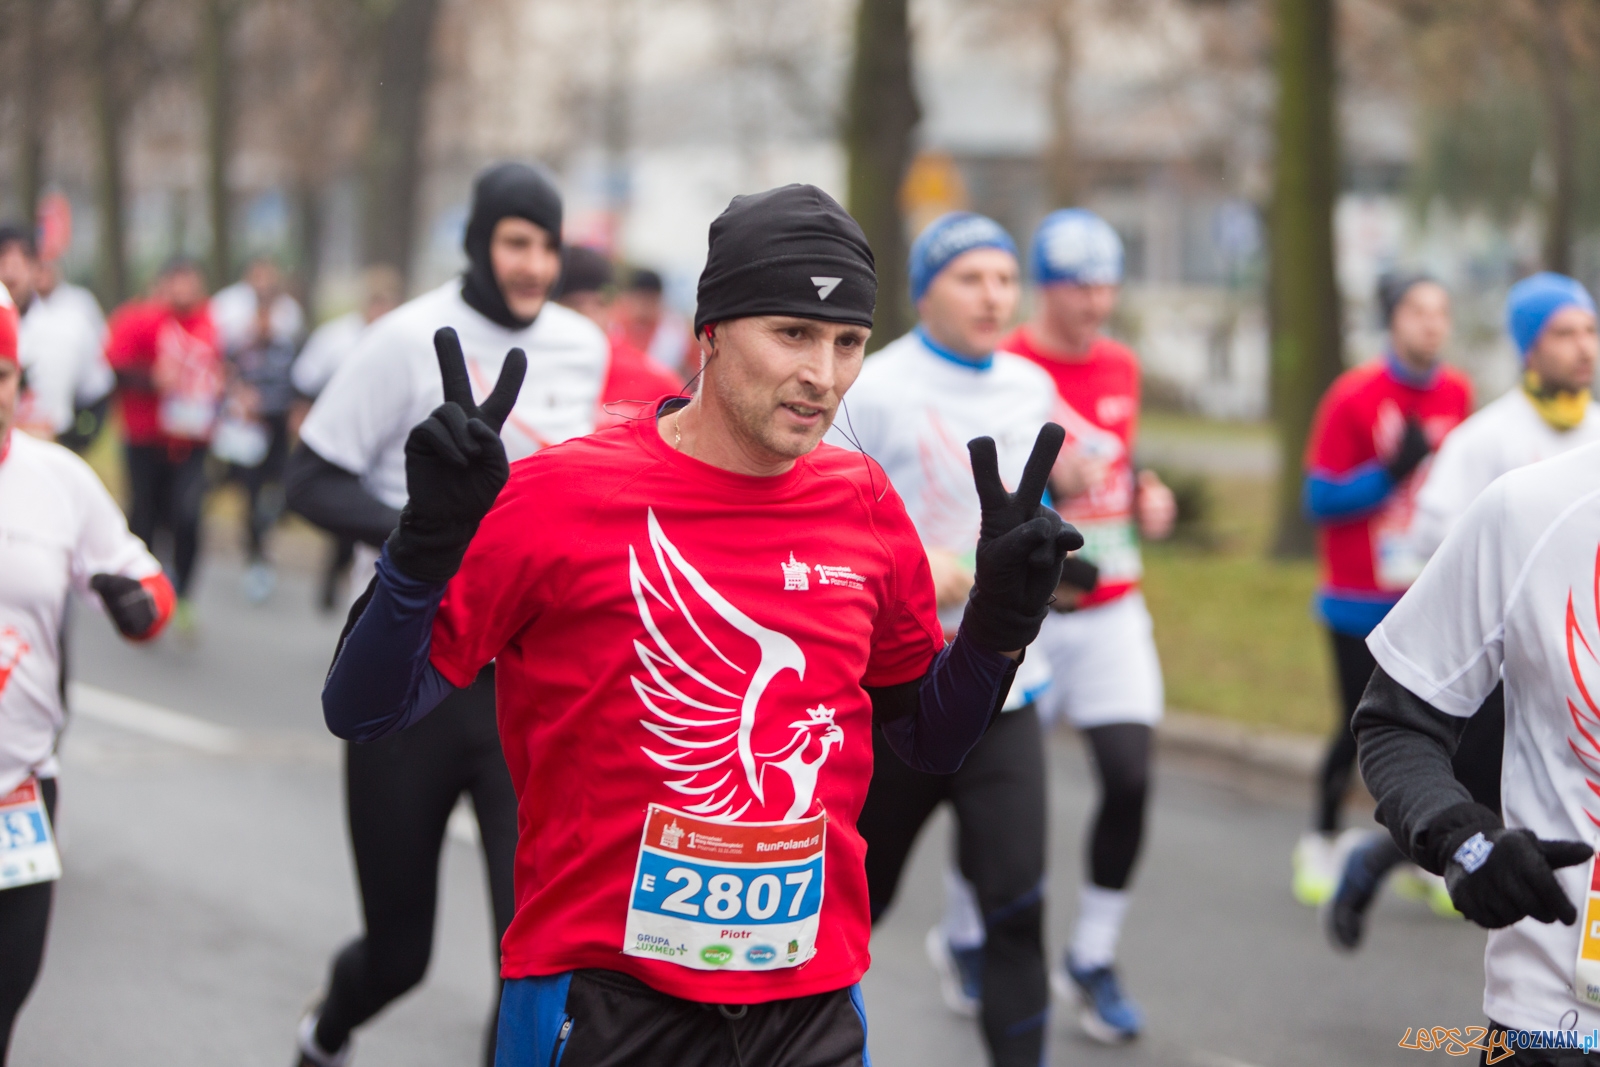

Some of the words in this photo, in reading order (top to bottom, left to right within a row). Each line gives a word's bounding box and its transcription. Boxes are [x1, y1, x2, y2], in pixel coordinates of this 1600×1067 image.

[687, 832, 697, 849] 1
[756, 834, 820, 852] RunPoland.org
[640, 873, 657, 893] E
[660, 866, 814, 920] 2807
[637, 933, 670, 947] GRUPA
[720, 929, 752, 939] Piotr
